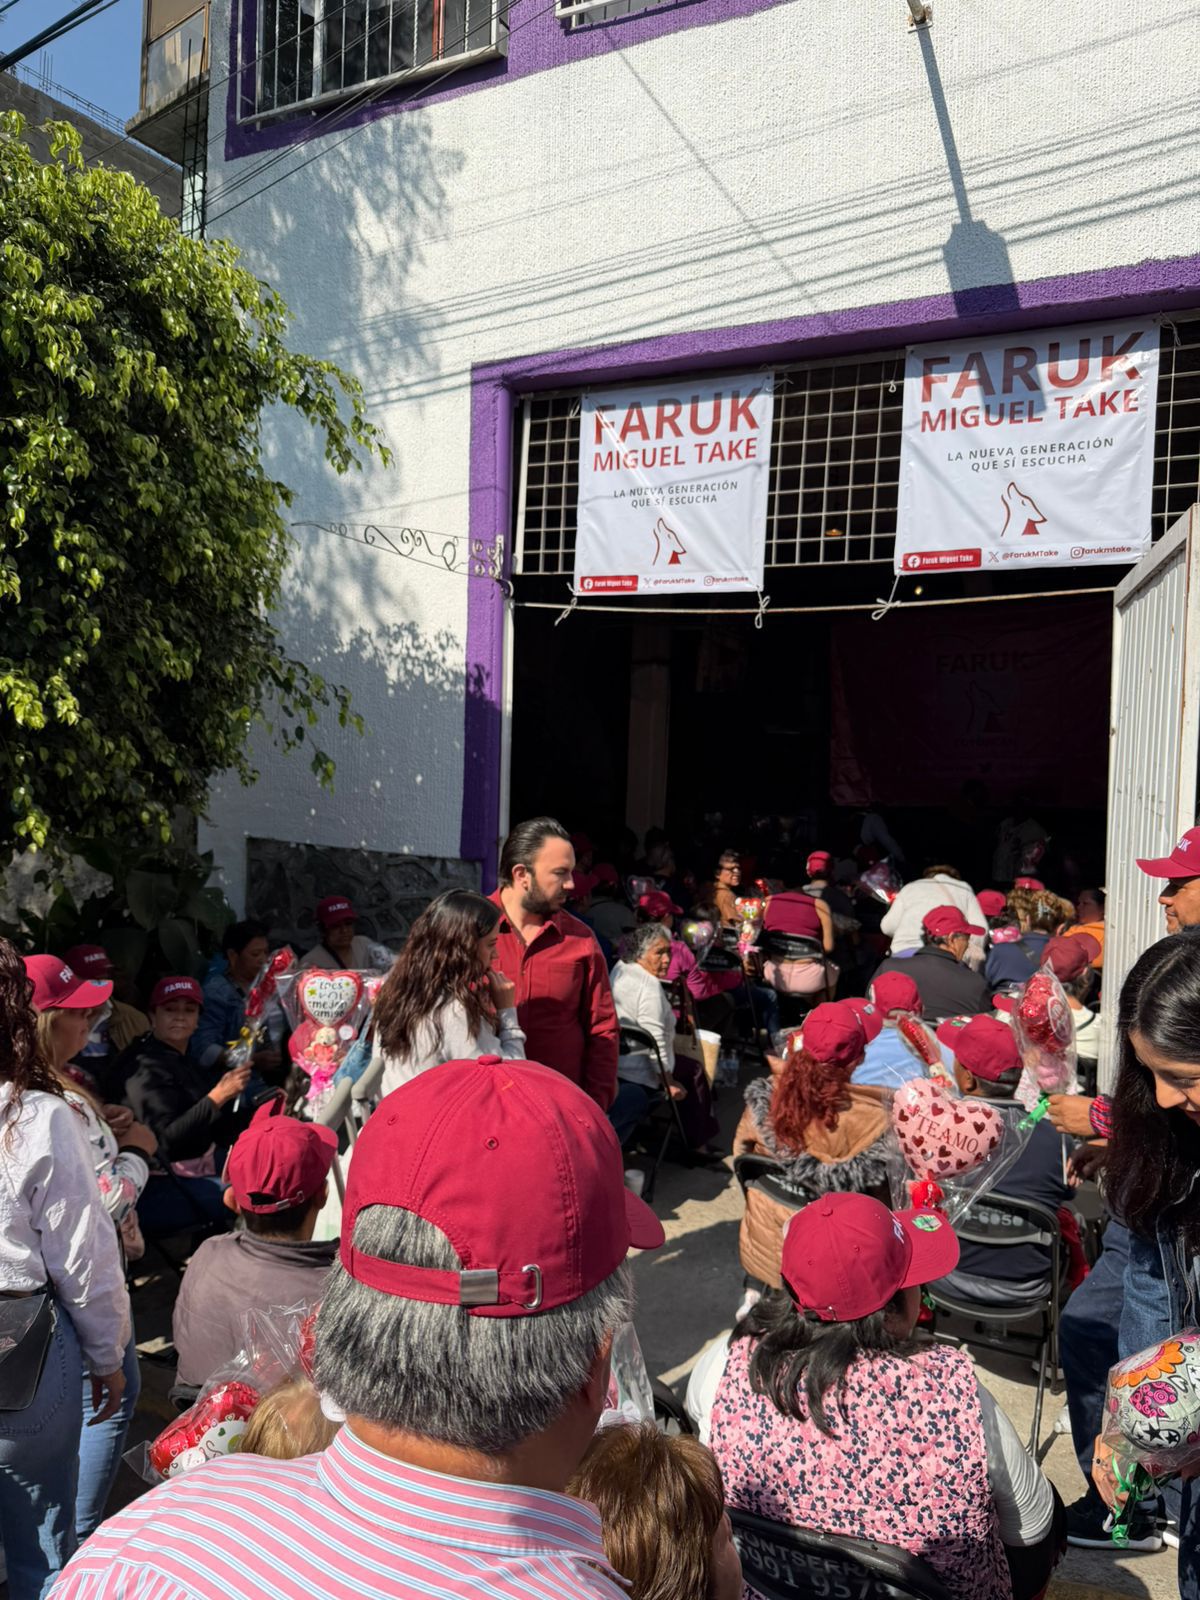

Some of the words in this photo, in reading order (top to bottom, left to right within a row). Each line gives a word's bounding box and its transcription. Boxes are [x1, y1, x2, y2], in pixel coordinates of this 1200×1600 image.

[921, 331, 1144, 403] FARUK
[594, 387, 762, 445] FARUK
[920, 400, 1043, 433] MIGUEL
[1055, 389, 1139, 420] TAKE
[593, 445, 686, 472] MIGUEL
[694, 437, 758, 464] TAKE
[947, 452, 963, 462] LA
[969, 447, 1014, 460] NUEVA
[1020, 437, 1113, 456] GENERACIÓN
[971, 460, 998, 473] QUE
[1003, 457, 1016, 469] SÍ
[1022, 453, 1086, 468] ESCUCHA
[613, 490, 626, 498] LA
[629, 487, 664, 497] NUEVA
[667, 480, 738, 495] GENERACIÓN
[631, 498, 650, 509] QUE
[669, 494, 718, 506] ESCUCHA
